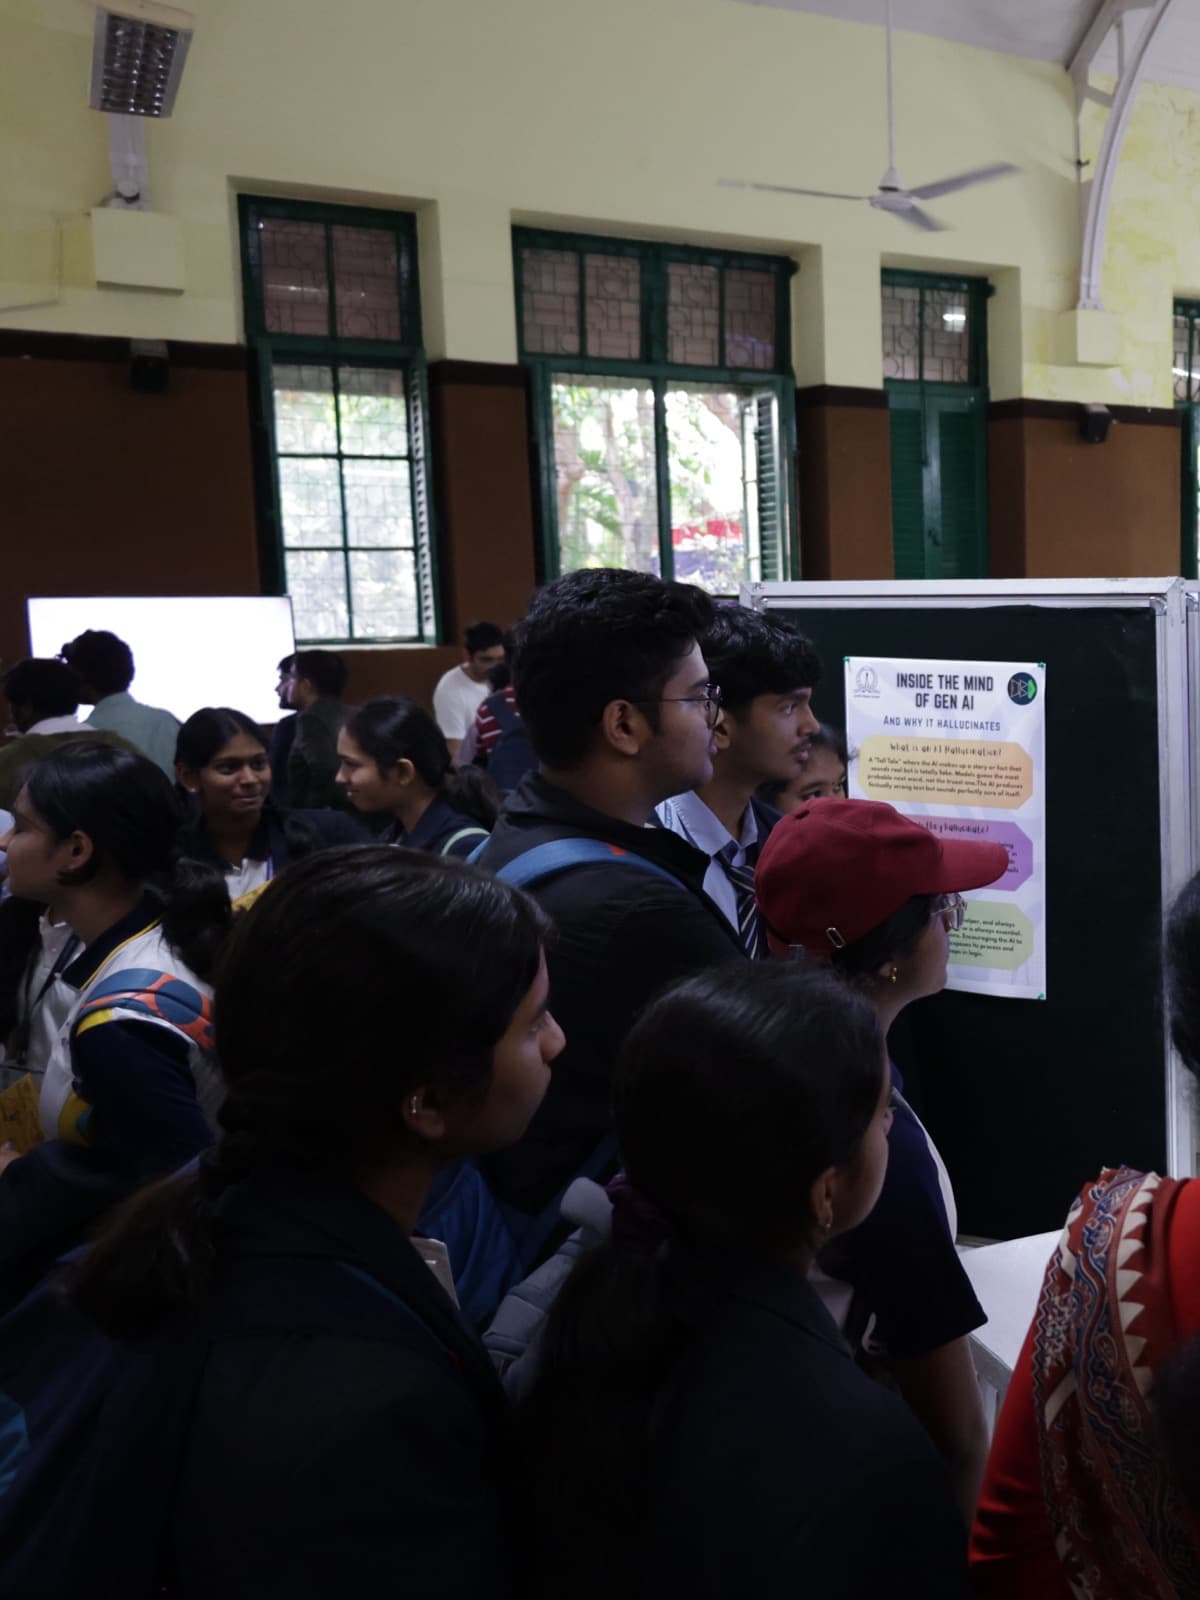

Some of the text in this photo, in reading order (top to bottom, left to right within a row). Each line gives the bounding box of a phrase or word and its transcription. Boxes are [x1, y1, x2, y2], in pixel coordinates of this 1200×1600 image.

[896, 672, 994, 692] INSIDE THE MIND
[915, 692, 974, 711] OF GEN AI
[883, 715, 1001, 732] AND WHY IT HALLUCINATES
